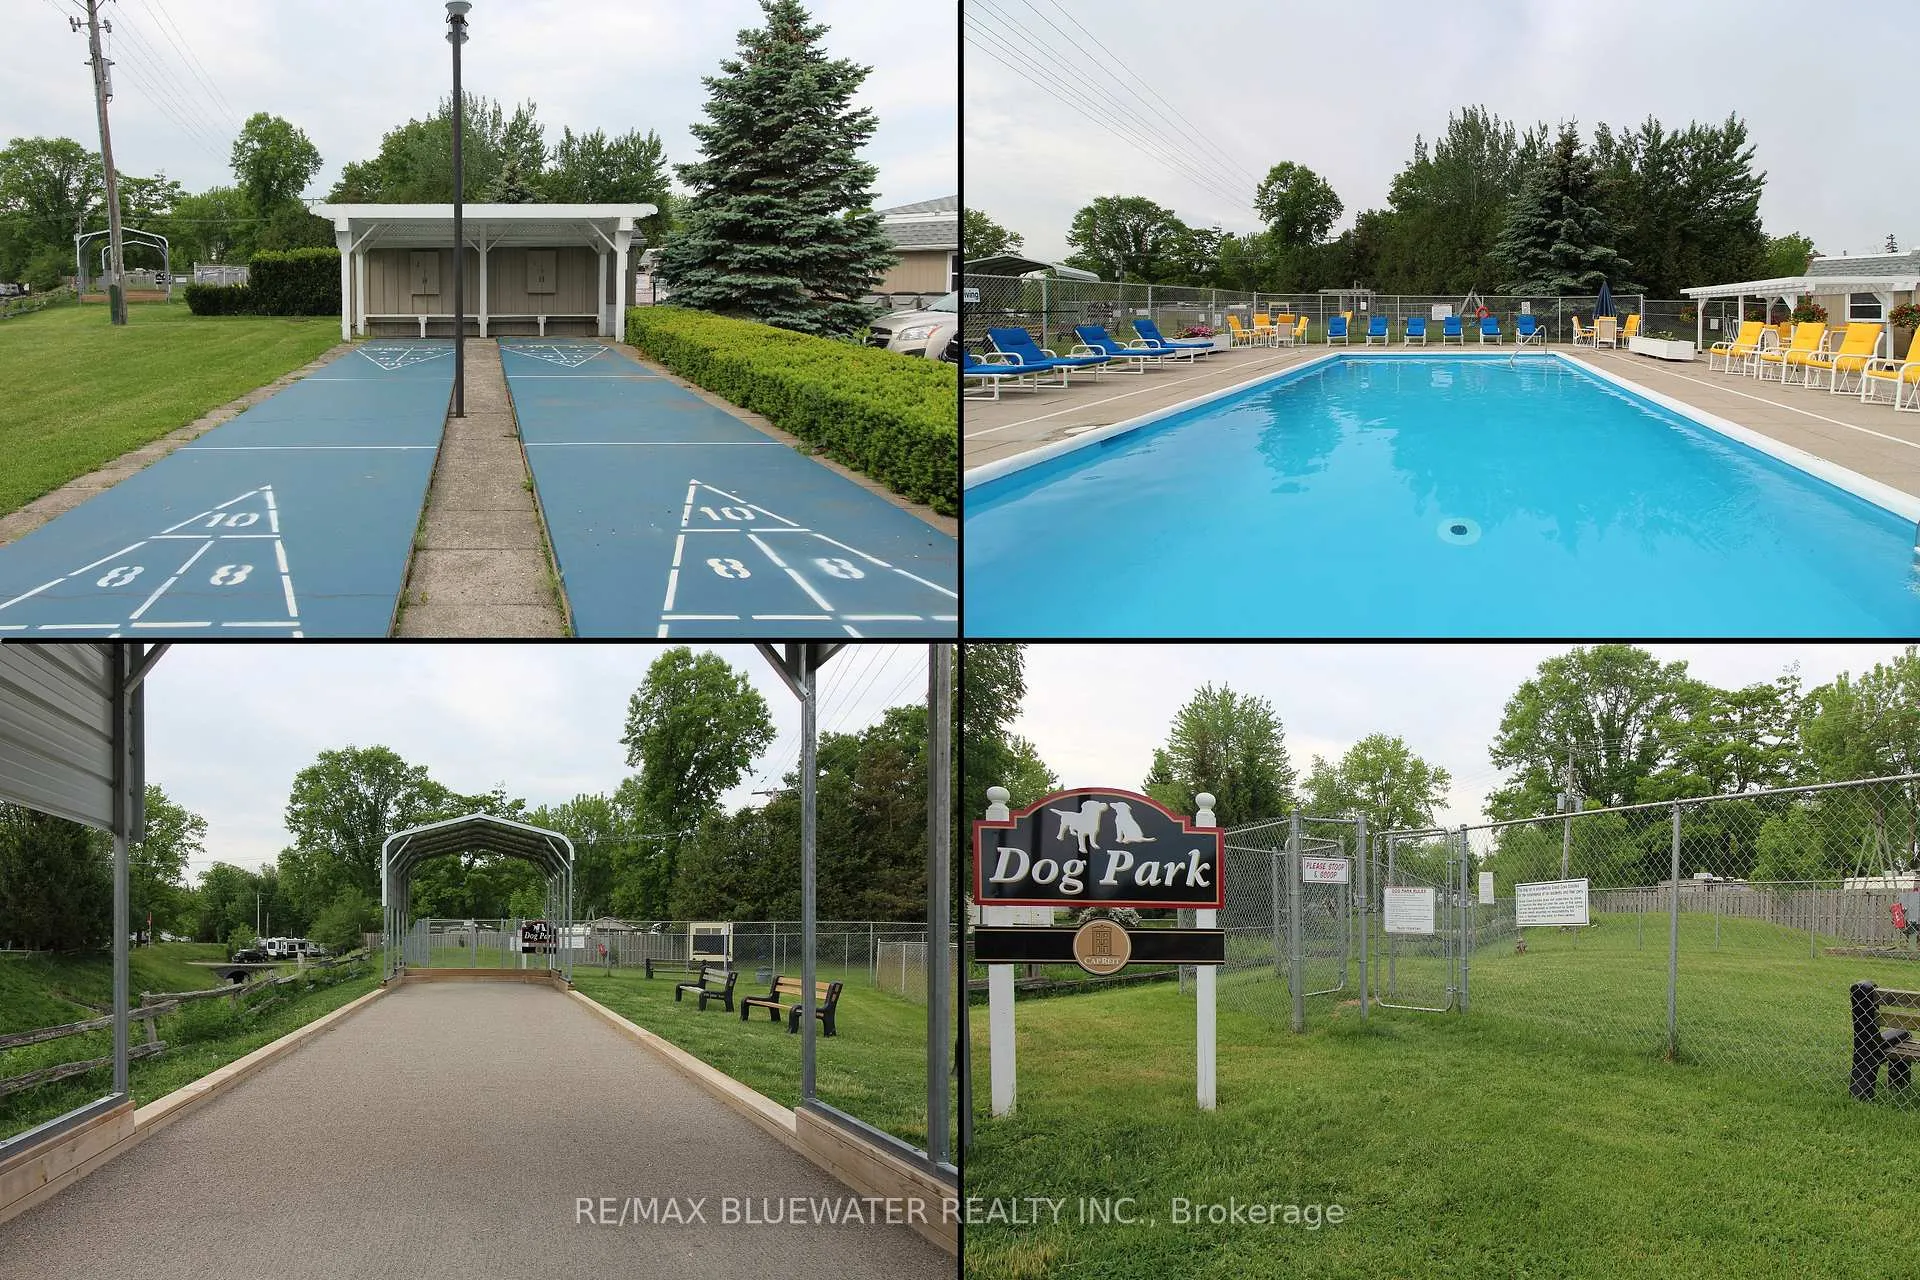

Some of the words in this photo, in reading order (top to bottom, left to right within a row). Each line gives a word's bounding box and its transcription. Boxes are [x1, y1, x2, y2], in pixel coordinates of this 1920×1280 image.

[205, 512, 260, 528] 10
[699, 506, 756, 521] 10
[96, 565, 145, 587] 8
[209, 564, 255, 586] 8
[706, 557, 752, 579] 8
[813, 557, 866, 580] 8
[988, 847, 1087, 895] Dog
[1099, 849, 1212, 888] Park
[1305, 861, 1327, 871] PLEASE
[524, 931, 538, 942] Dog
